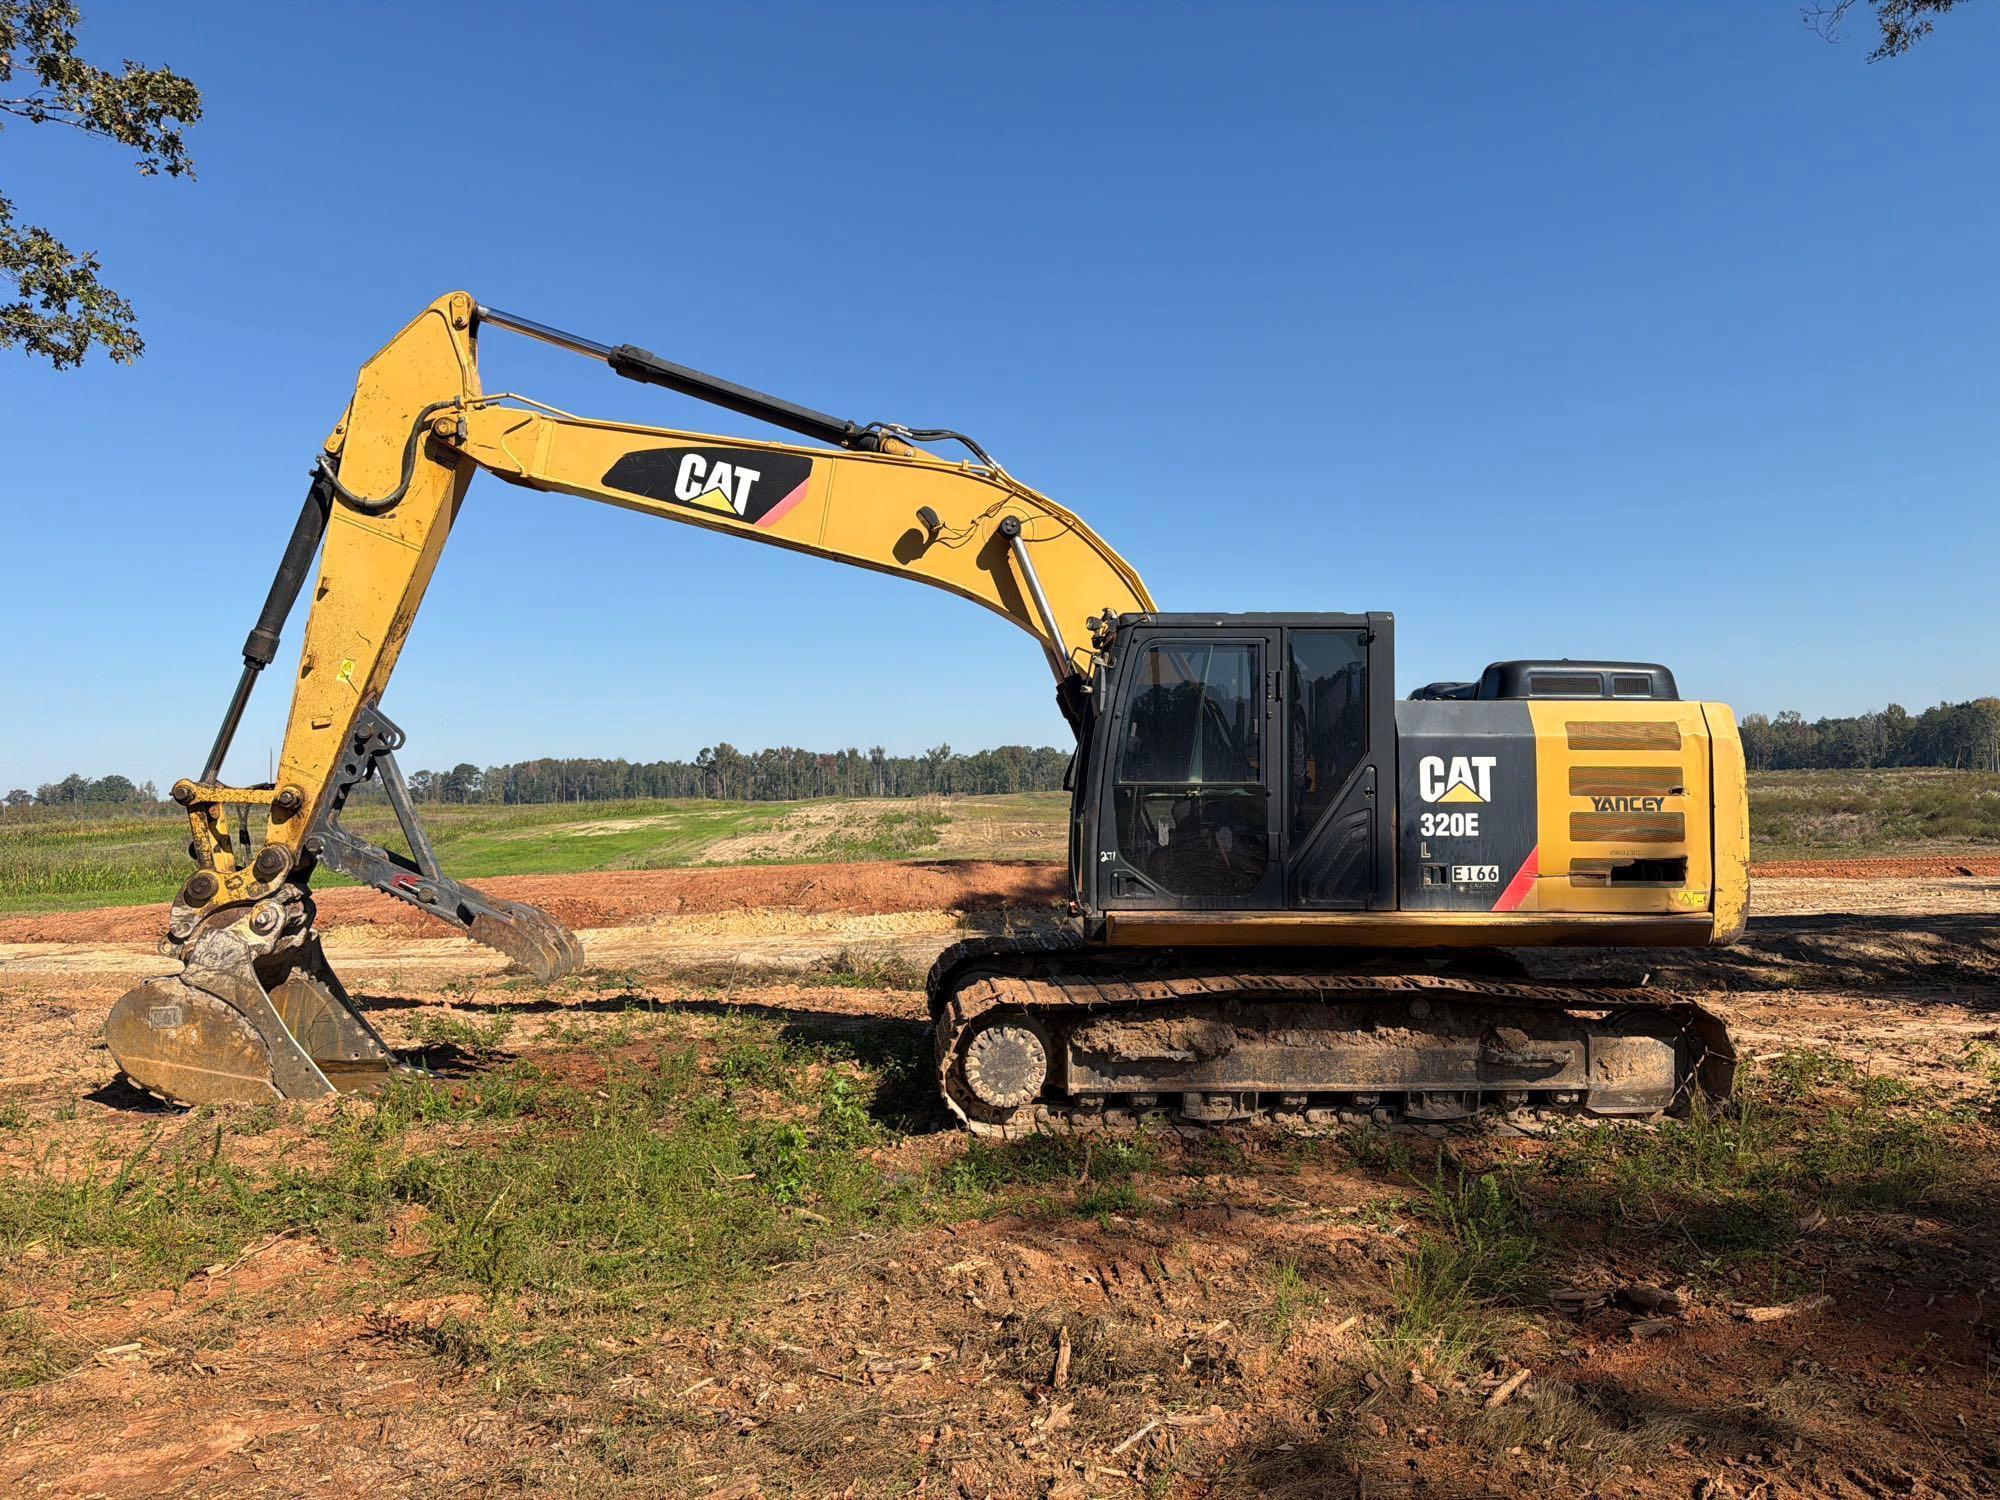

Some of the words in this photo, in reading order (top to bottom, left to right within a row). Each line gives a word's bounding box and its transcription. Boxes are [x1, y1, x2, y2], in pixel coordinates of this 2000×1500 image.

[674, 453, 761, 516] CAT
[1419, 755, 1497, 803] CAT
[1590, 796, 1666, 812] YANCEY
[1420, 812, 1480, 837] 320E
[1420, 841, 1431, 858] L
[1453, 866, 1498, 881] E166
